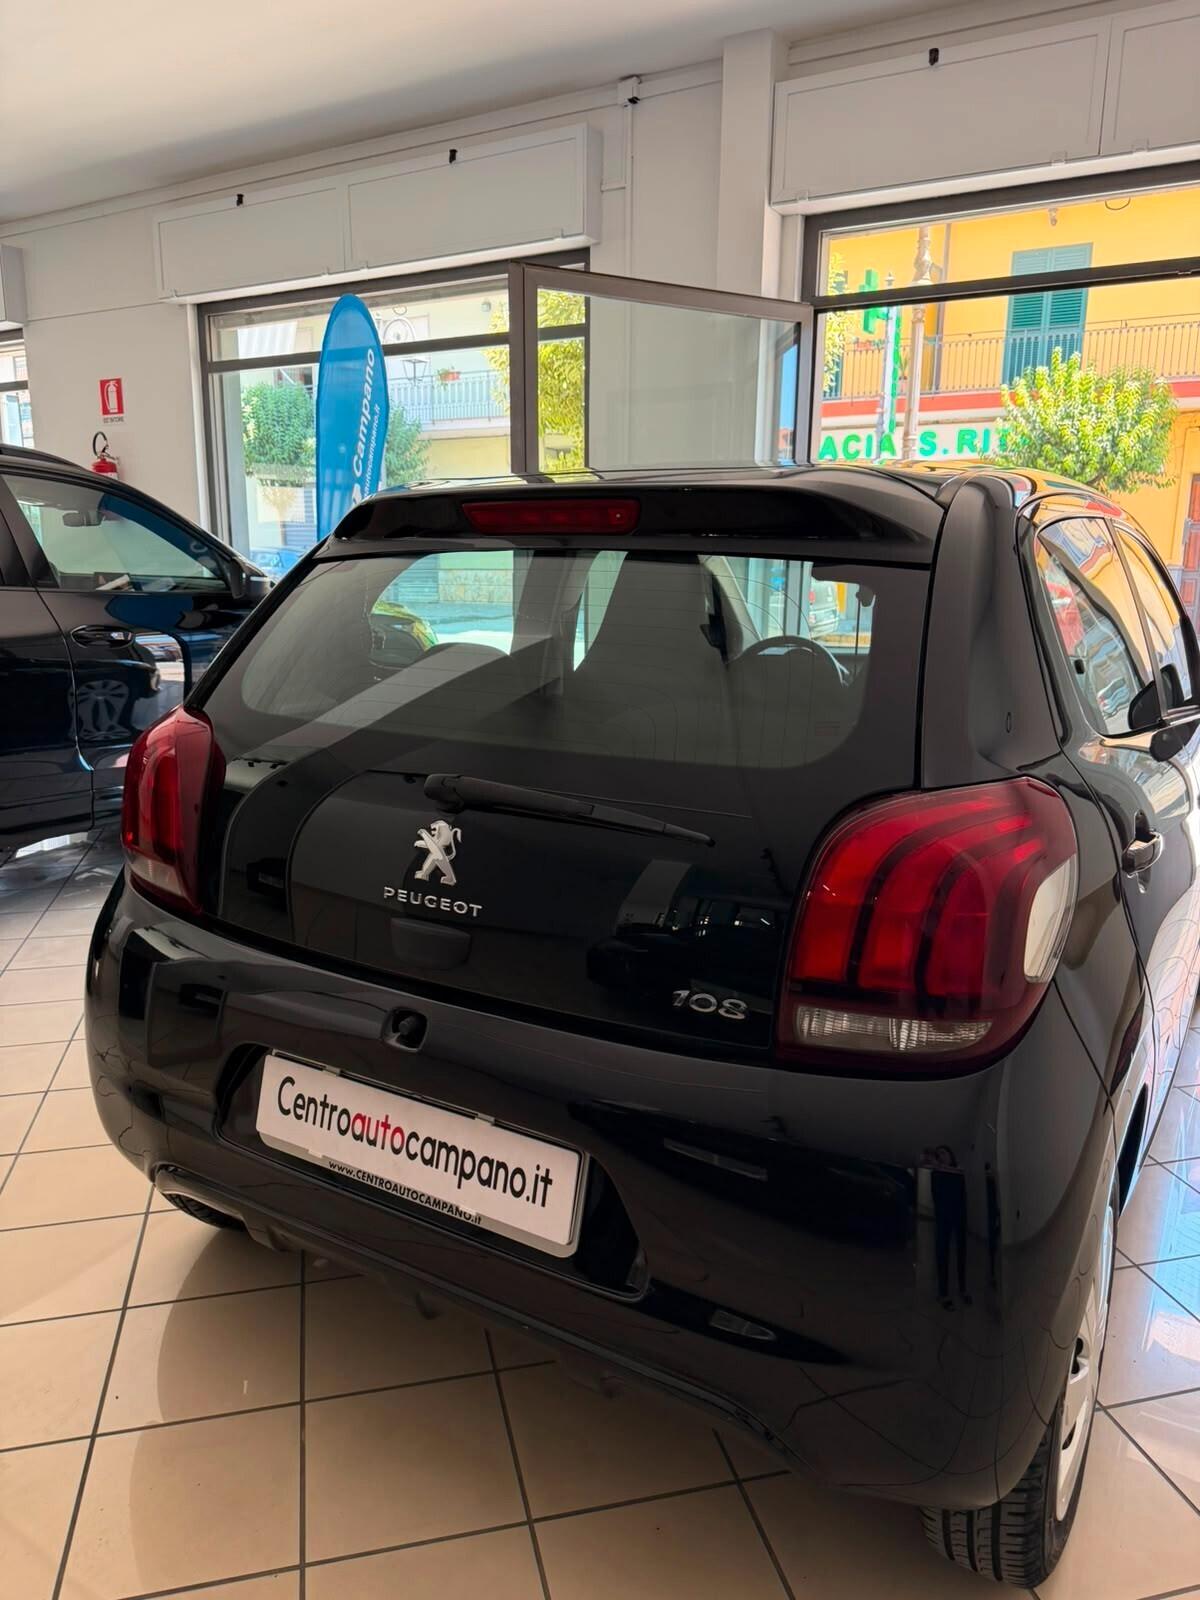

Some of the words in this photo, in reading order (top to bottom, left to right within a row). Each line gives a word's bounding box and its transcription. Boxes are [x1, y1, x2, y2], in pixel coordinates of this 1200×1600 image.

[353, 348, 375, 478] Campano
[383, 886, 483, 917] PEUGEOT
[672, 989, 747, 1019] 108
[277, 1076, 553, 1208] Centroautocampano.it
[328, 1160, 482, 1225] www.CENTROAUTOCAMPANO.it
